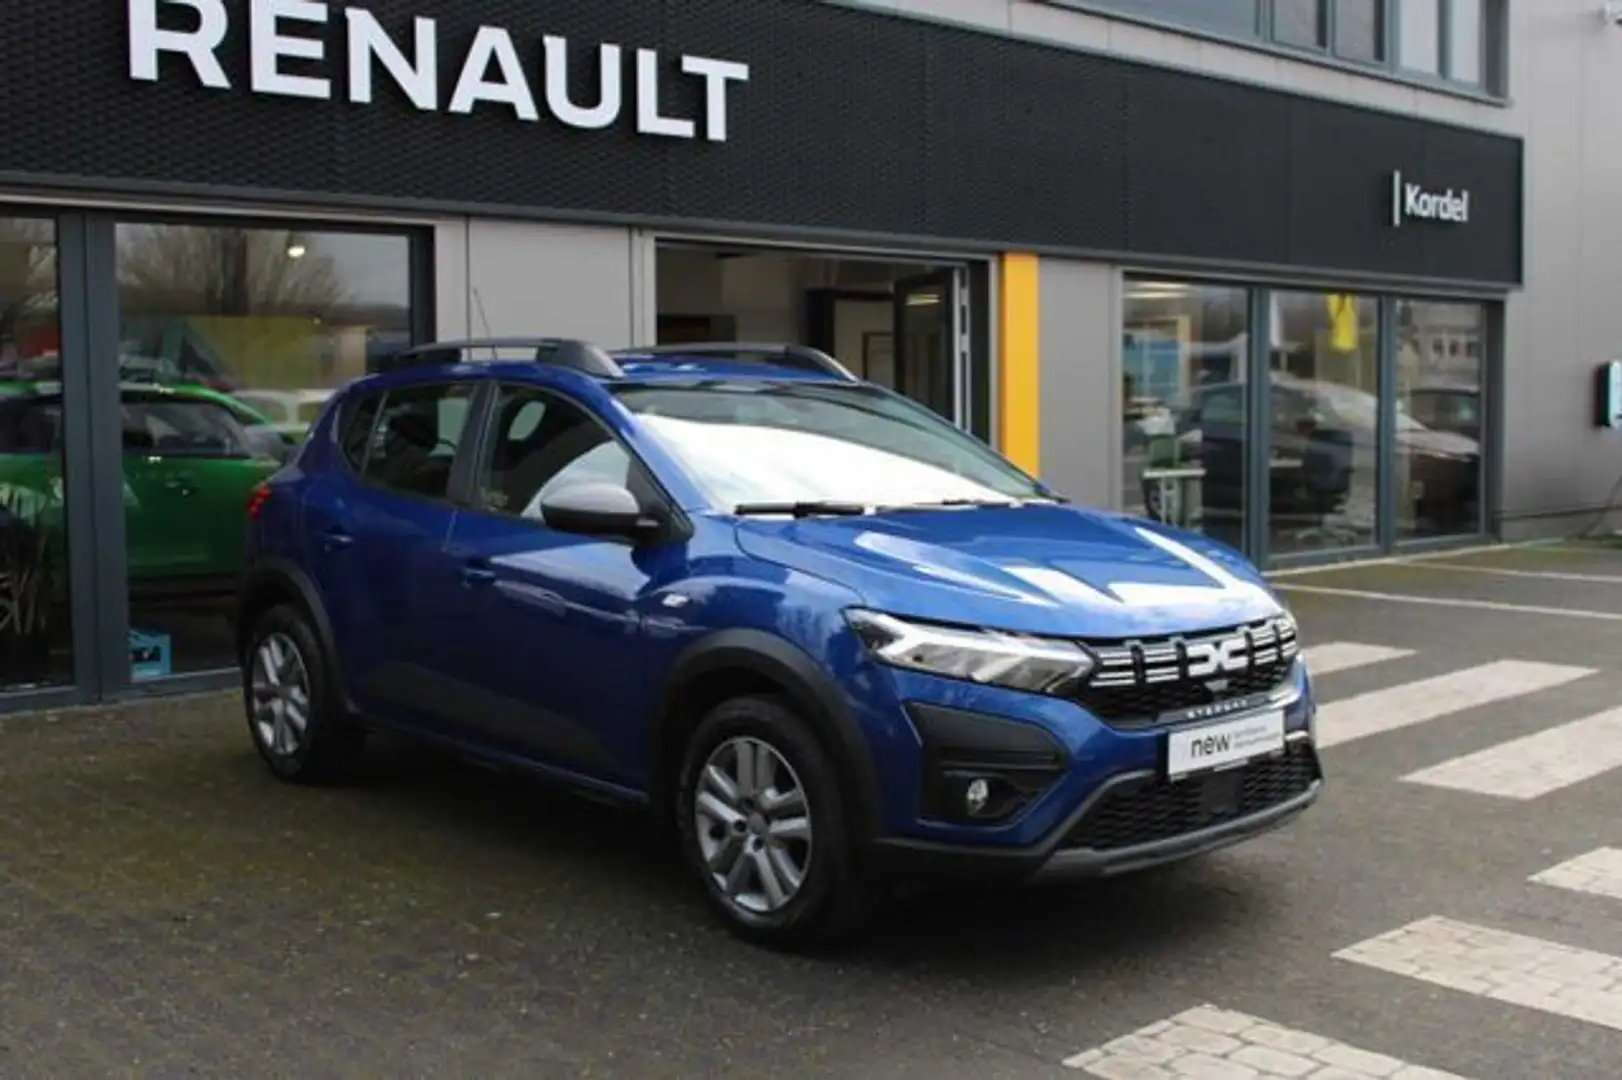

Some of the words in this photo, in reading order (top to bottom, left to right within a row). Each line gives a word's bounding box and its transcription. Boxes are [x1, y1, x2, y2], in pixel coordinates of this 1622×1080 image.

[128, 0, 749, 142] RENAULT
[1404, 182, 1469, 223] Kordel
[1190, 733, 1231, 758] new
